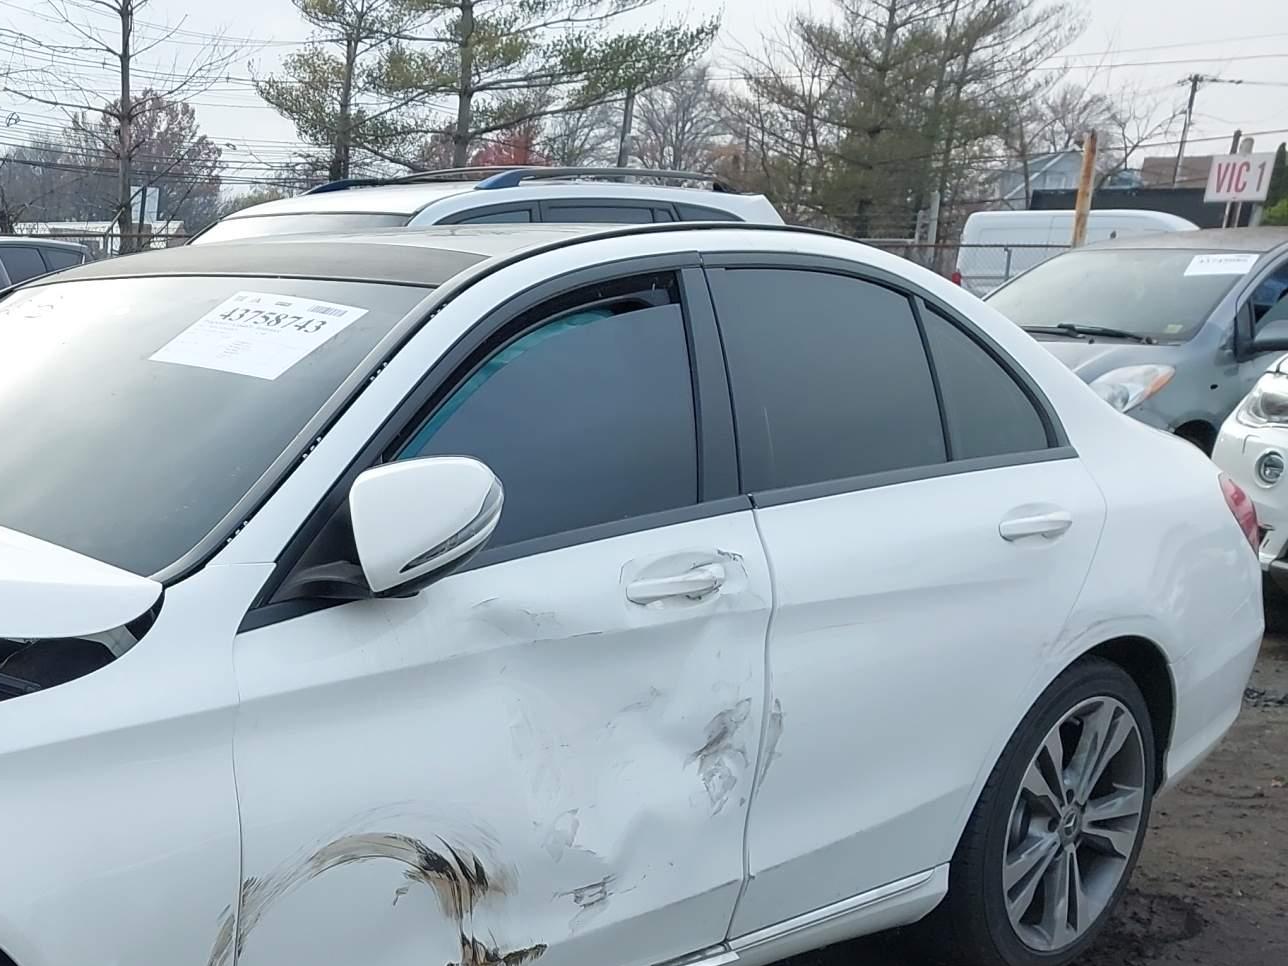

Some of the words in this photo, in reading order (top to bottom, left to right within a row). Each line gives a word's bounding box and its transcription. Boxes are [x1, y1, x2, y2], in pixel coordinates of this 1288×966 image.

[1216, 161, 1250, 193] VIC
[1256, 161, 1266, 192] 1
[219, 306, 328, 334] 43758743
